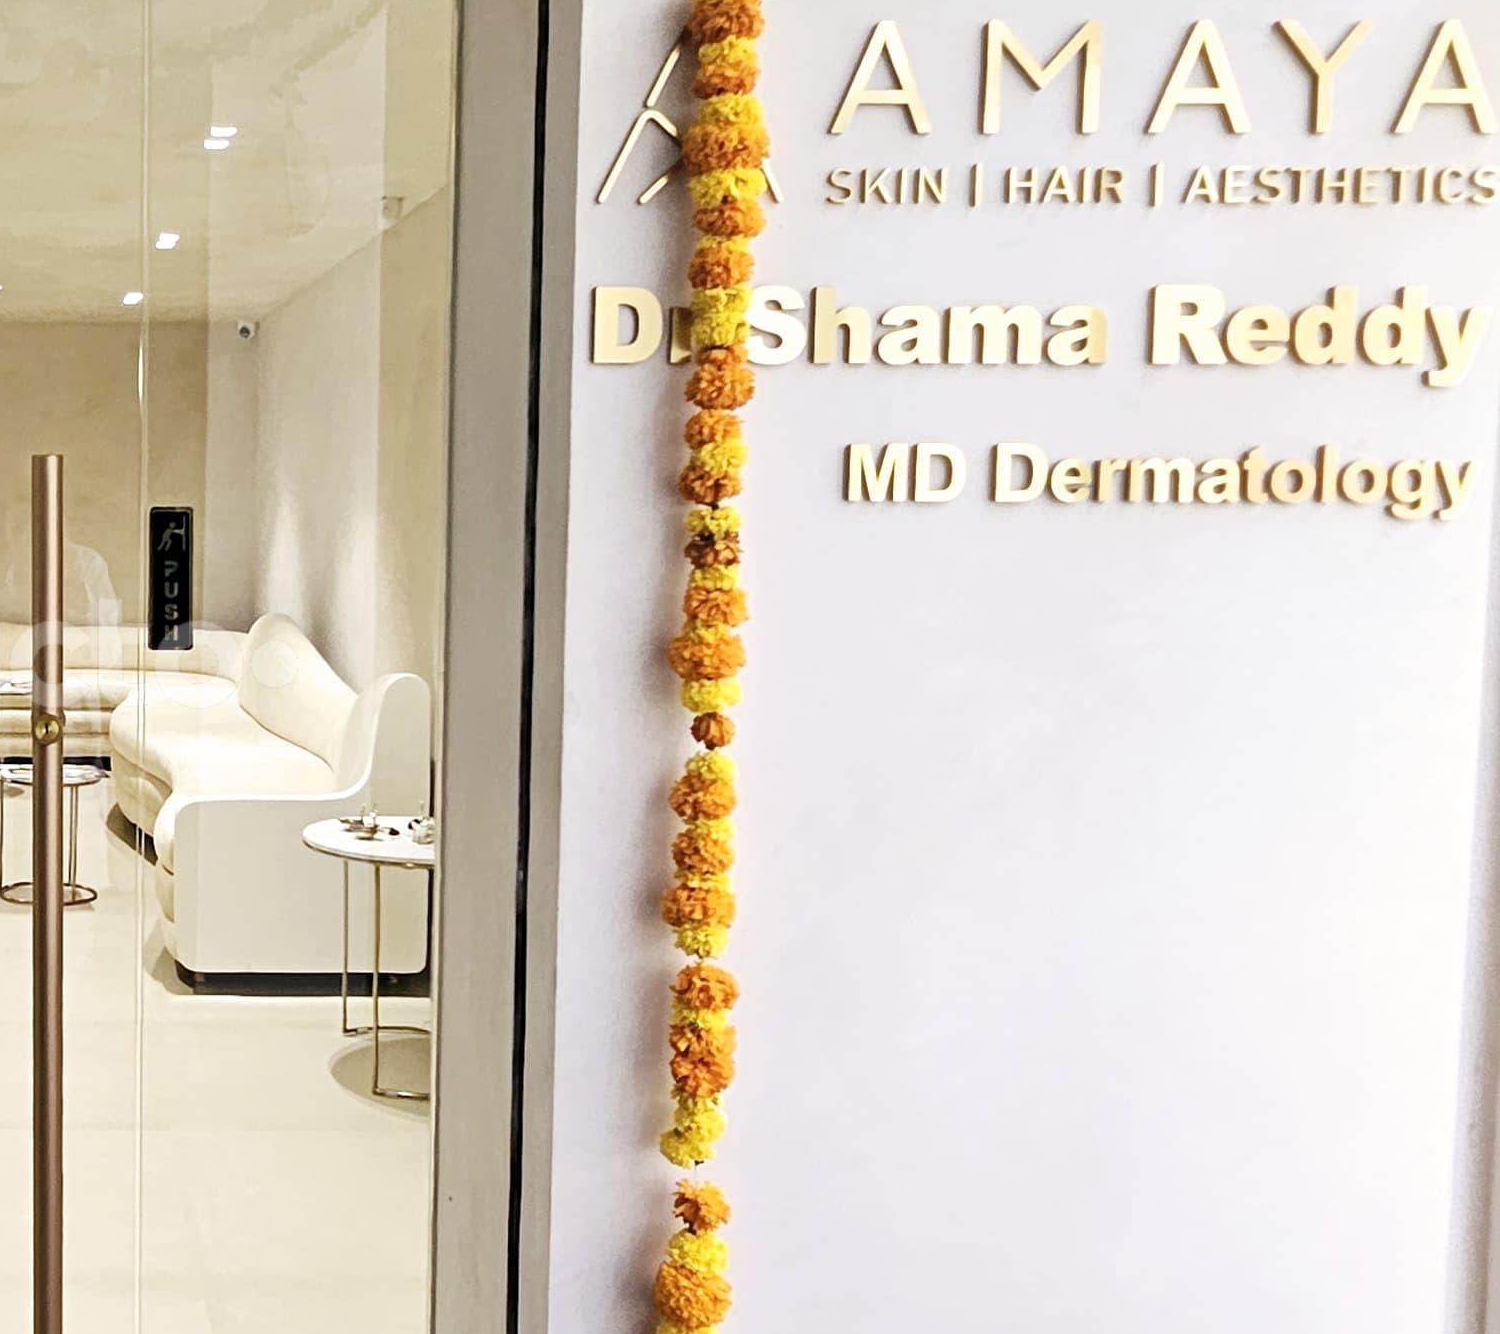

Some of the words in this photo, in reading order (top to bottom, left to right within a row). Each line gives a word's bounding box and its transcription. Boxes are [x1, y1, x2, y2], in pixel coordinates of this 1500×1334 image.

[828, 17, 1499, 136] AMAYA
[825, 167, 949, 205] SKIN
[1005, 166, 1124, 204] HAIR
[1181, 165, 1500, 206] AESTHETICS
[747, 284, 1107, 366] Shama
[1149, 284, 1493, 387] Reddy
[846, 443, 966, 503] MD
[993, 442, 1480, 522] Dermatology
